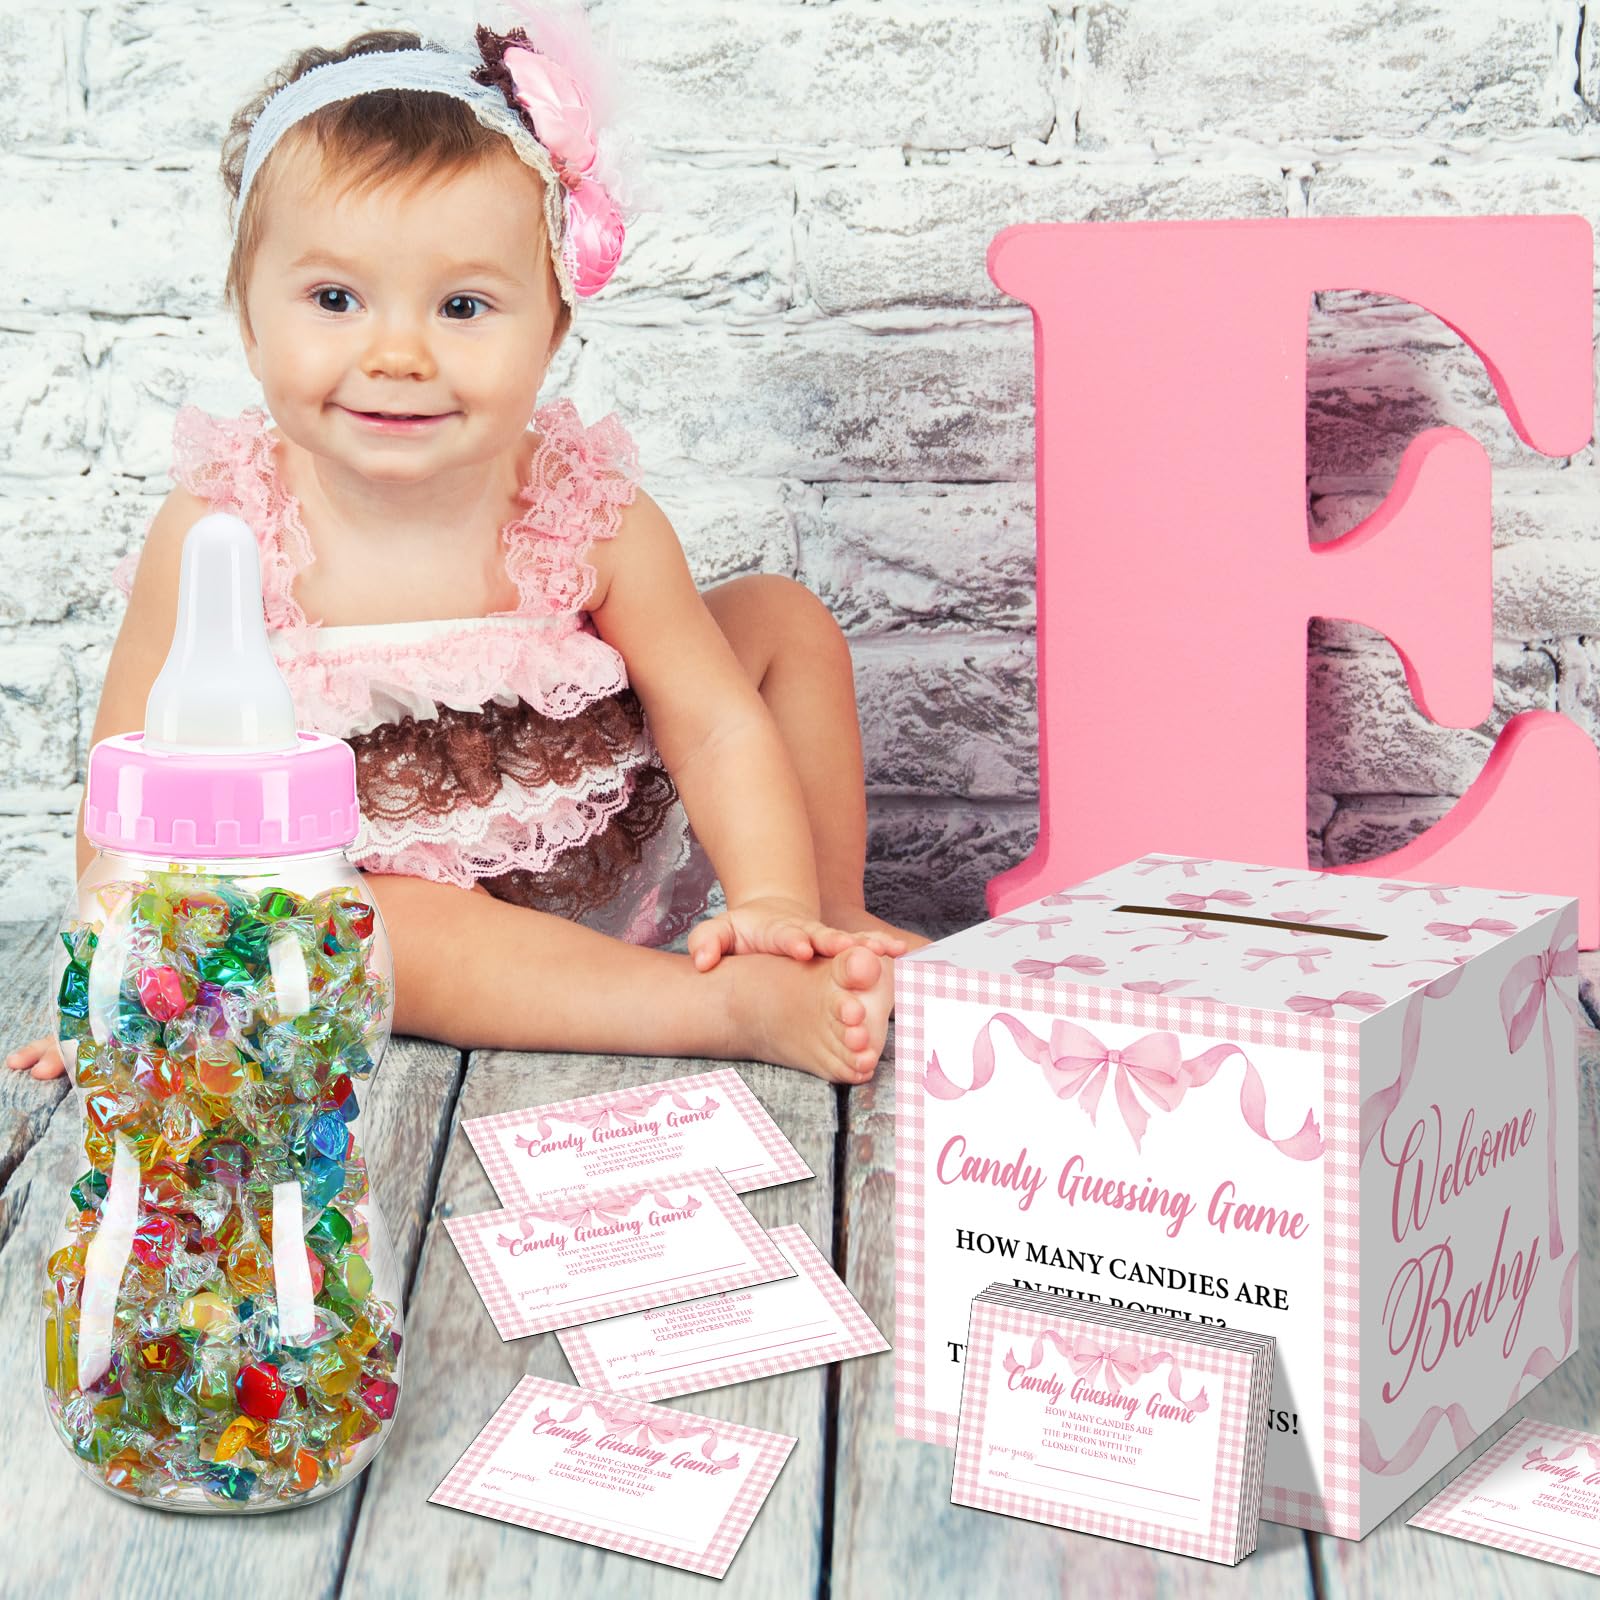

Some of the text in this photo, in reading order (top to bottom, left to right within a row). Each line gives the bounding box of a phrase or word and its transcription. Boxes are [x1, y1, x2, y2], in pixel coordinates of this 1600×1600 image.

[987, 214, 1600, 952] E
[527, 1110, 714, 1157] Candy Guessing Game
[936, 1134, 1309, 1240] Candy Guessing Game
[1381, 1104, 1537, 1244] Welcome
[509, 1209, 696, 1257] Candy Guessing Game
[956, 1228, 1020, 1259] HOW
[1025, 1241, 1104, 1275] MANY
[1109, 1258, 1230, 1300] CANDIES
[1235, 1282, 1290, 1311] ARE
[643, 1293, 753, 1321] HOW MANY CANDIES ARE
[651, 1308, 753, 1335] THE PERSON WITH THE
[677, 1313, 697, 1322] THE
[1382, 1205, 1541, 1404] Baby
[656, 1329, 695, 1342] CLOSEST
[696, 1321, 724, 1333] GUESS
[1007, 1365, 1197, 1424] Candy Guessing Game
[1045, 1406, 1153, 1436] HOW MANY CANDIES ARE
[1061, 1421, 1072, 1429] IN
[1074, 1423, 1092, 1433] THE
[533, 1419, 723, 1476] Candy Guessing Game
[1041, 1439, 1136, 1465] CLOSEST GUESS WINS!
[1042, 1428, 1143, 1455] THE PERSON WITH THE
[1522, 1457, 1582, 1483] Candy
